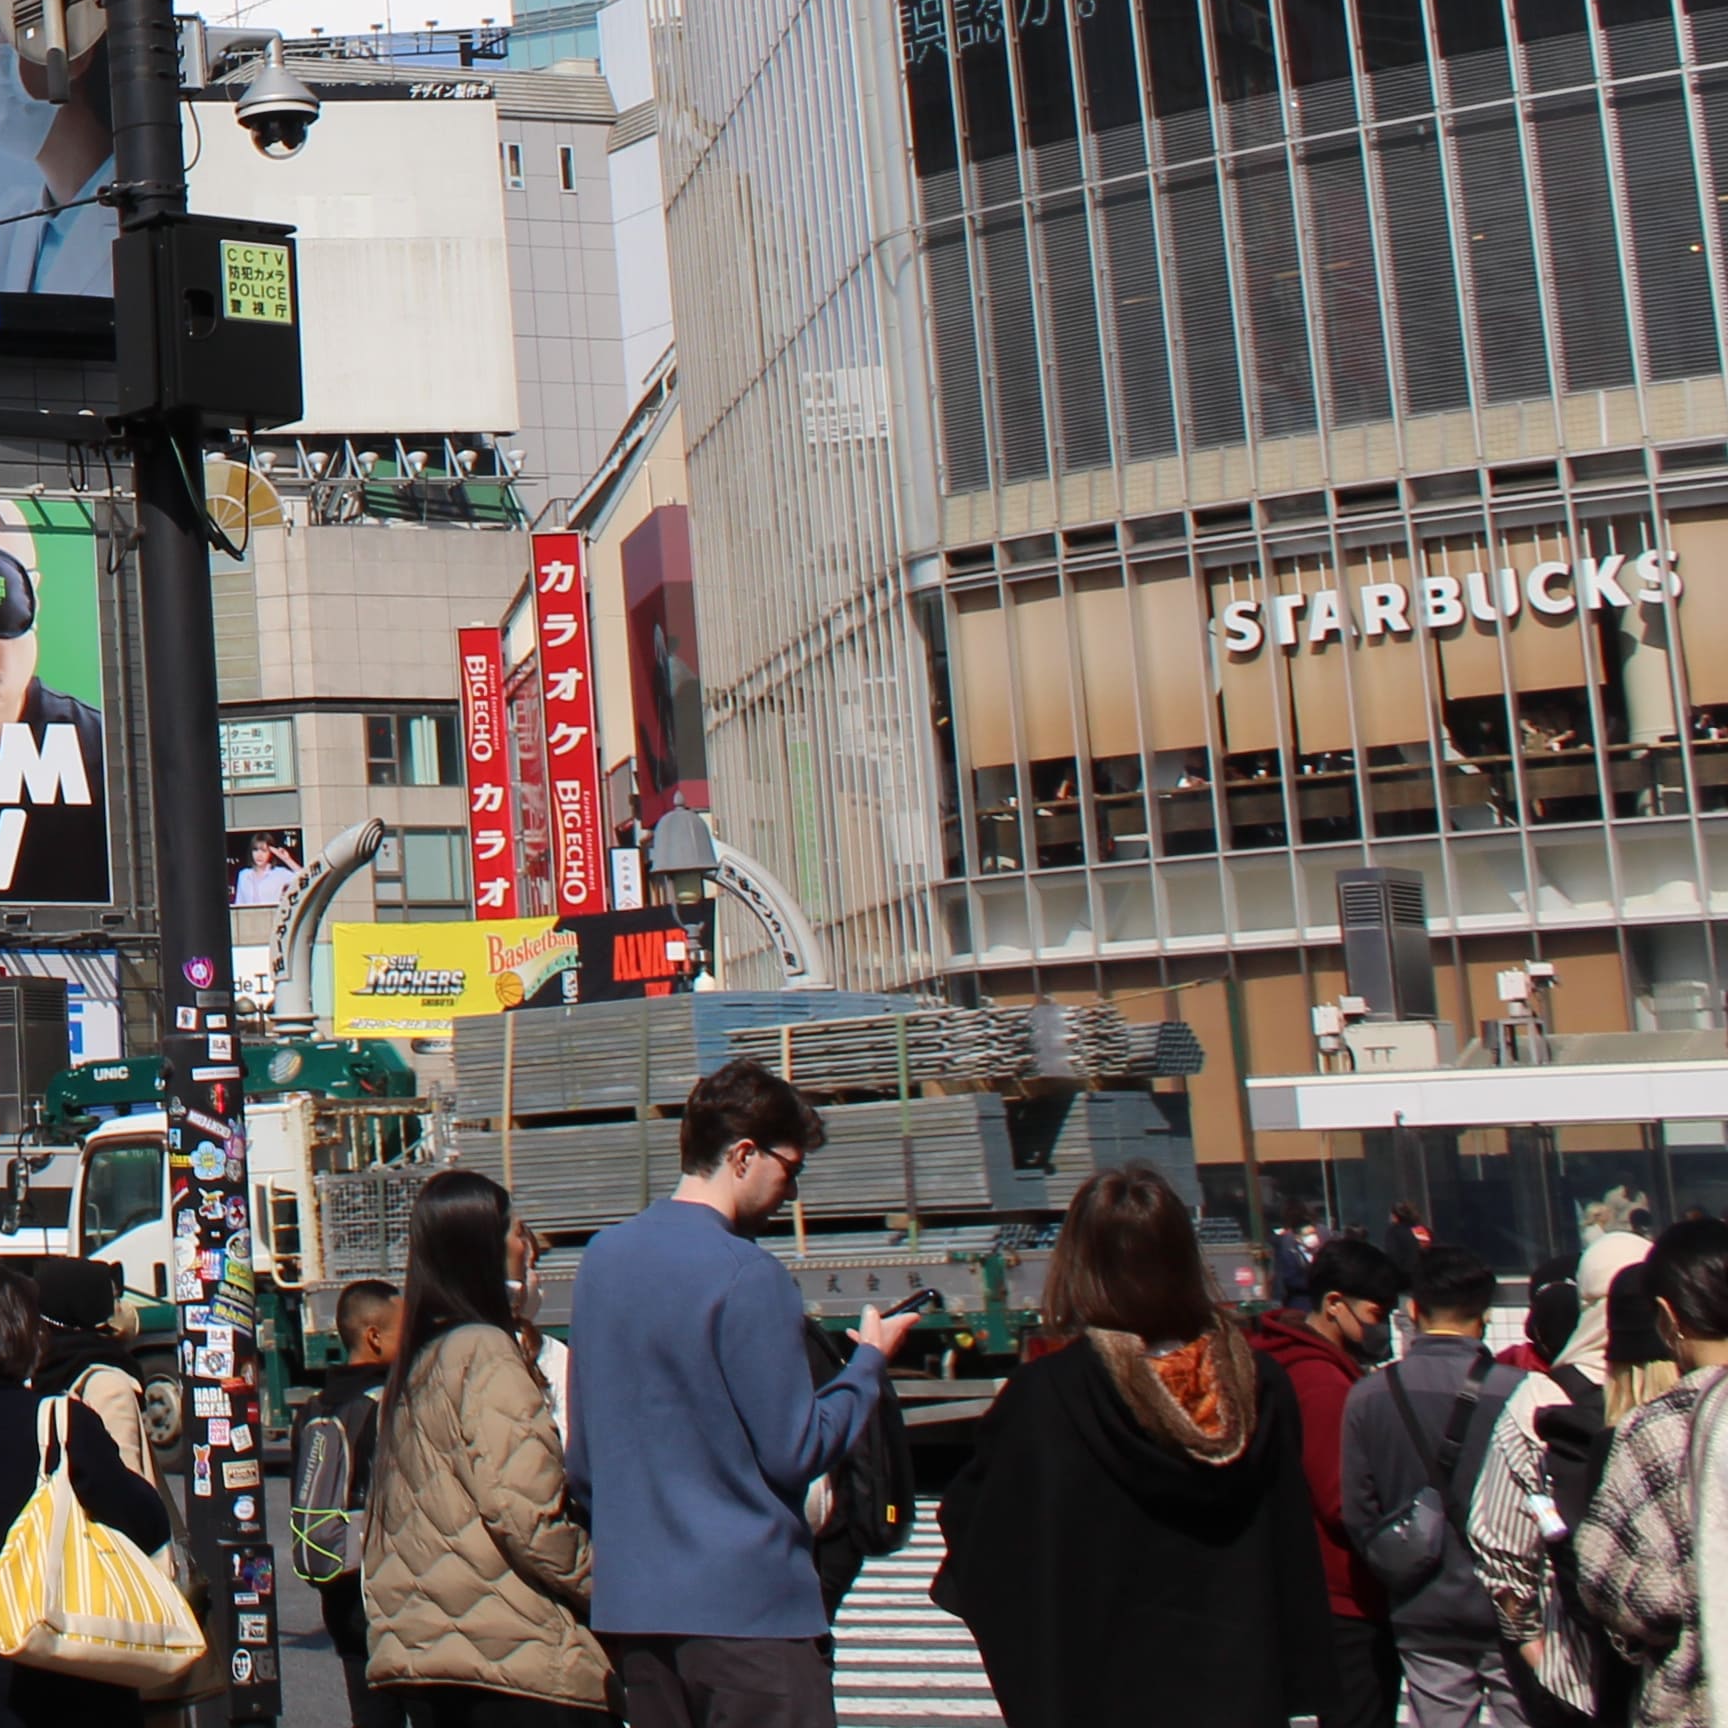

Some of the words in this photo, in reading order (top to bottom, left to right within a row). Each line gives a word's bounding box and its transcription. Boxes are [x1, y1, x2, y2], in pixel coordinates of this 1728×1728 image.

[226, 247, 286, 264] CCTV
[227, 263, 287, 284] 防犯カメラ
[227, 282, 289, 302] POLICE
[229, 299, 288, 320] 警視庁
[1223, 549, 1683, 655] STARBUCKS
[465, 654, 488, 698] BIG
[538, 560, 590, 757] カラオケ
[470, 702, 493, 763] ECHO
[555, 779, 582, 830] BIG
[471, 782, 511, 908] カラオ
[561, 833, 589, 905] ECHO
[350, 954, 466, 997] ROCKERS
[388, 955, 420, 971] SUN
[93, 1065, 130, 1083] UNIC
